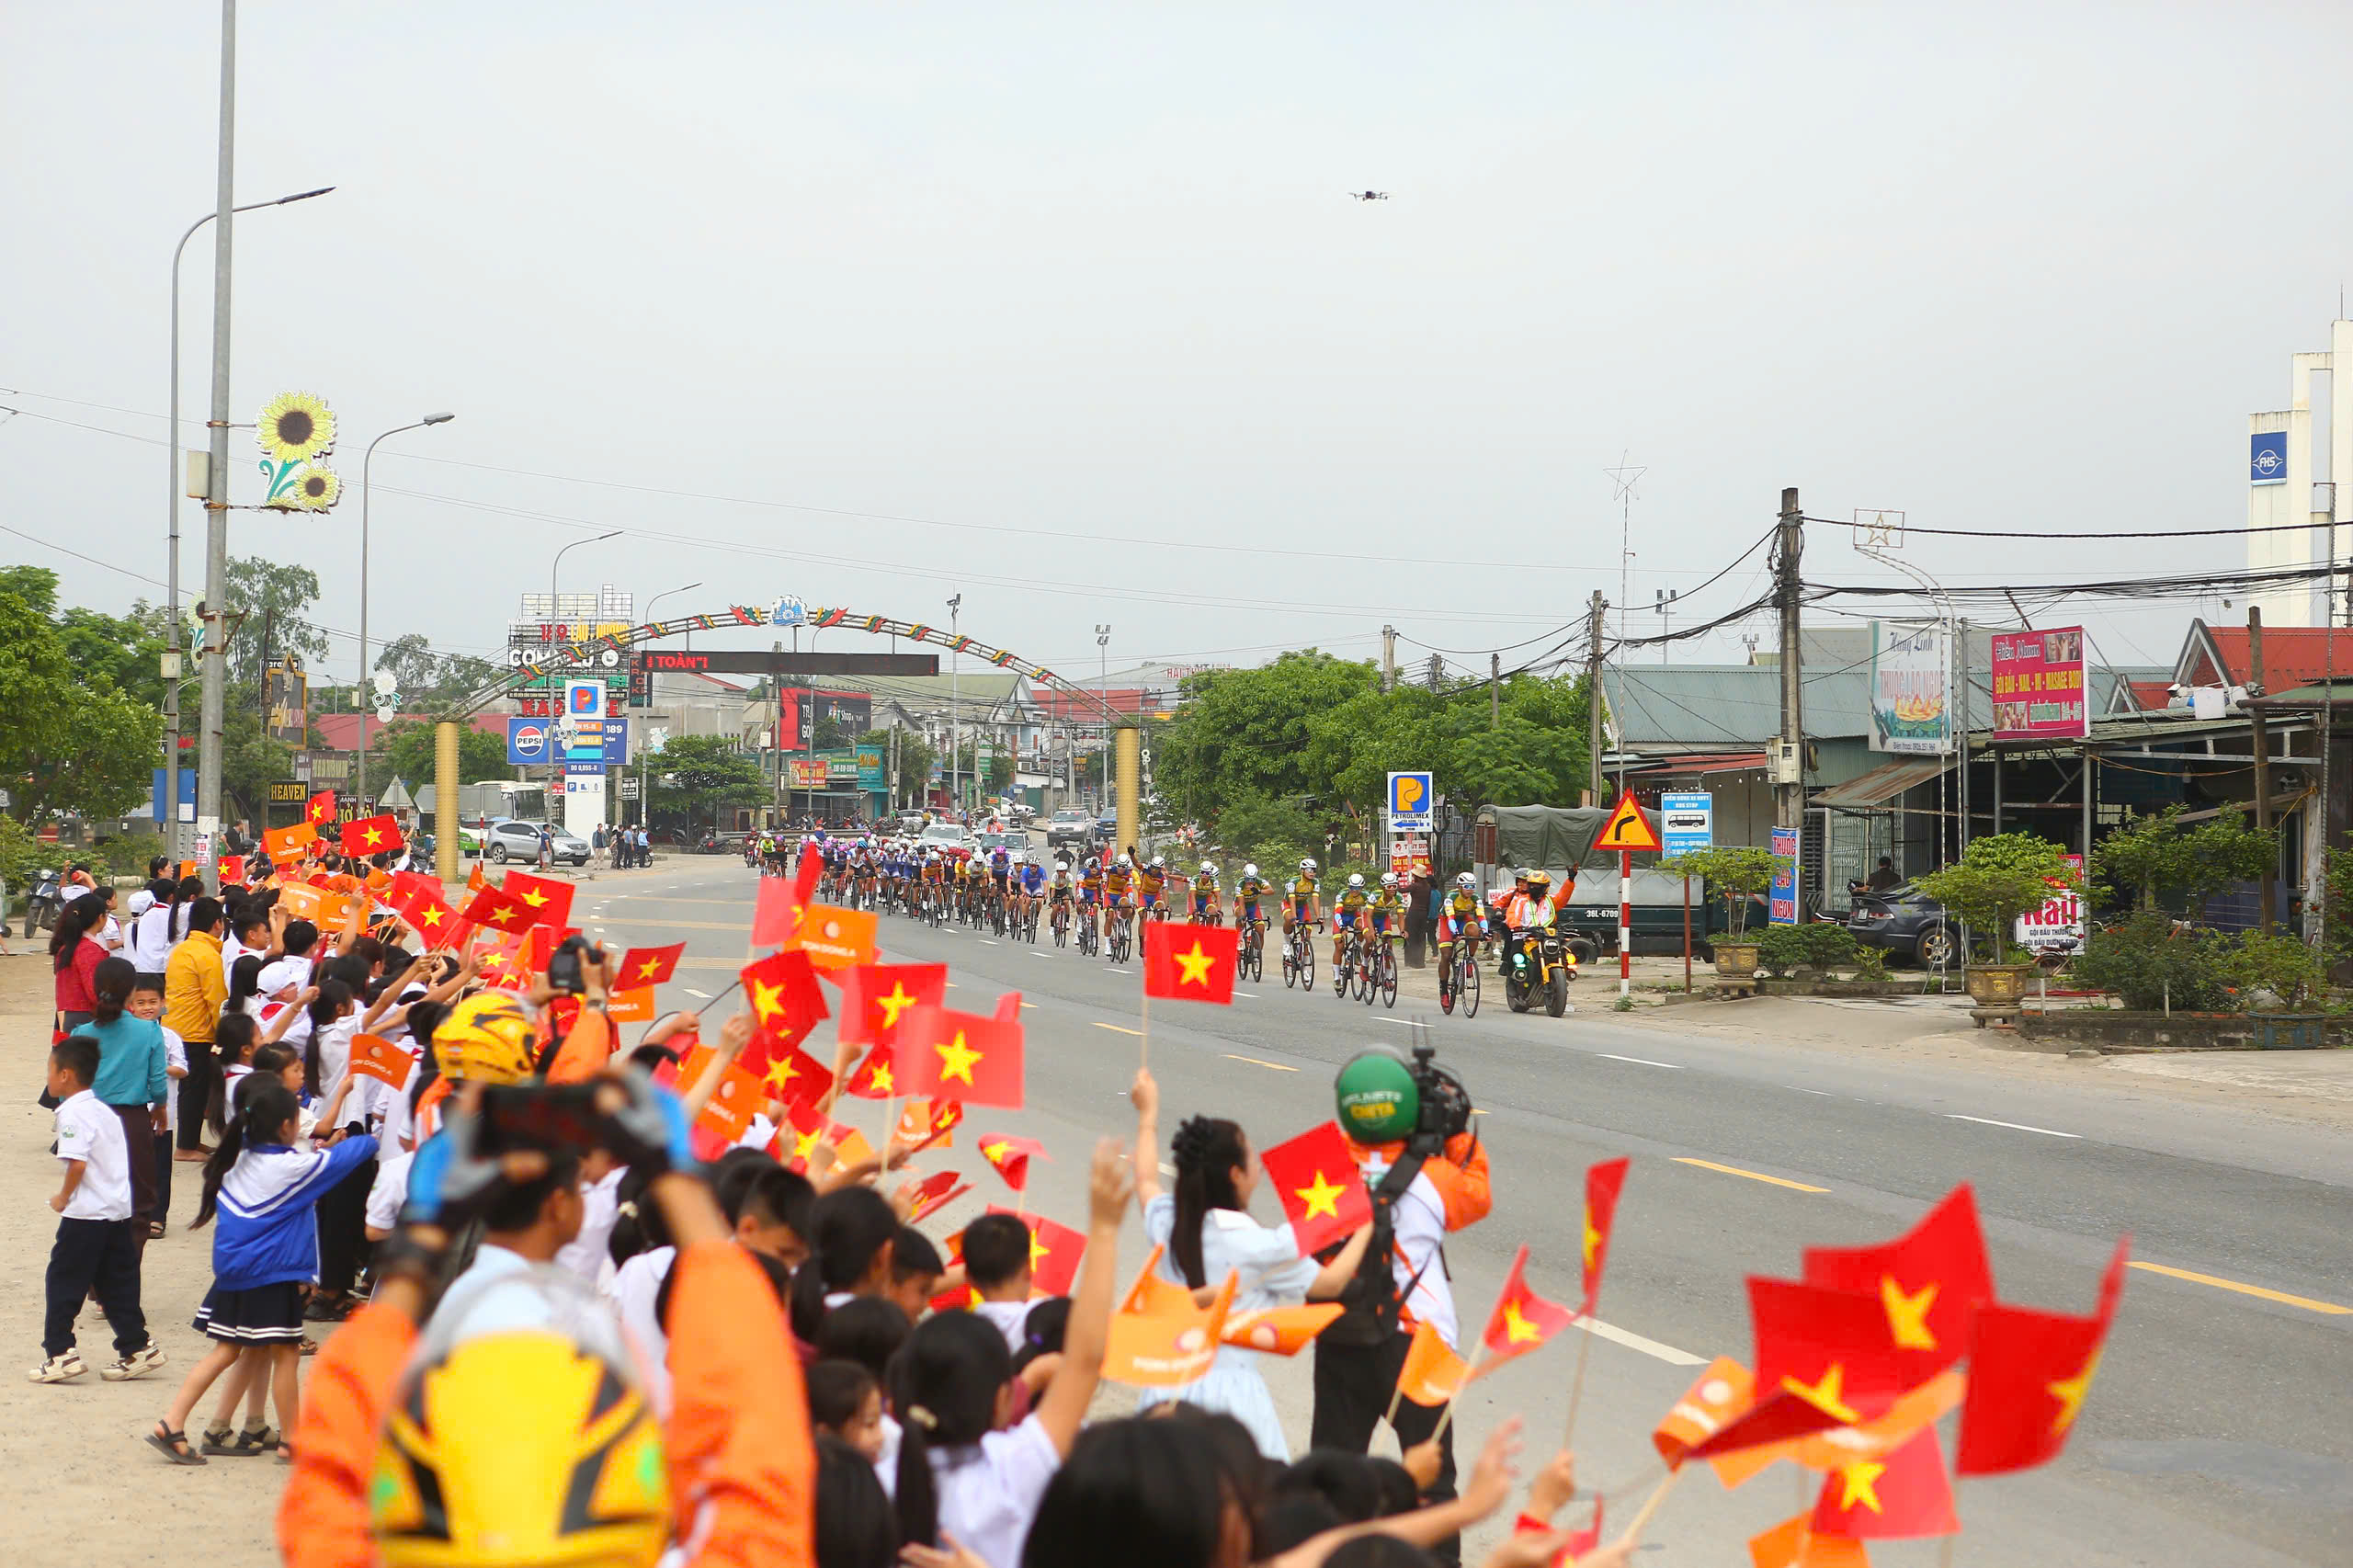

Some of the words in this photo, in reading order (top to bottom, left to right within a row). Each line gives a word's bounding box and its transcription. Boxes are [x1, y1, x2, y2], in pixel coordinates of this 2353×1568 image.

[2259, 456, 2276, 468] FHS
[522, 699, 620, 716] KARE
[606, 724, 623, 733] 189
[517, 737, 542, 745] PEPSI
[271, 784, 306, 801] HEAVEN
[1773, 831, 1797, 856] THUỐC
[1771, 899, 1794, 920] NGON
[822, 943, 847, 956] DONG
[363, 1060, 386, 1073] DONG
